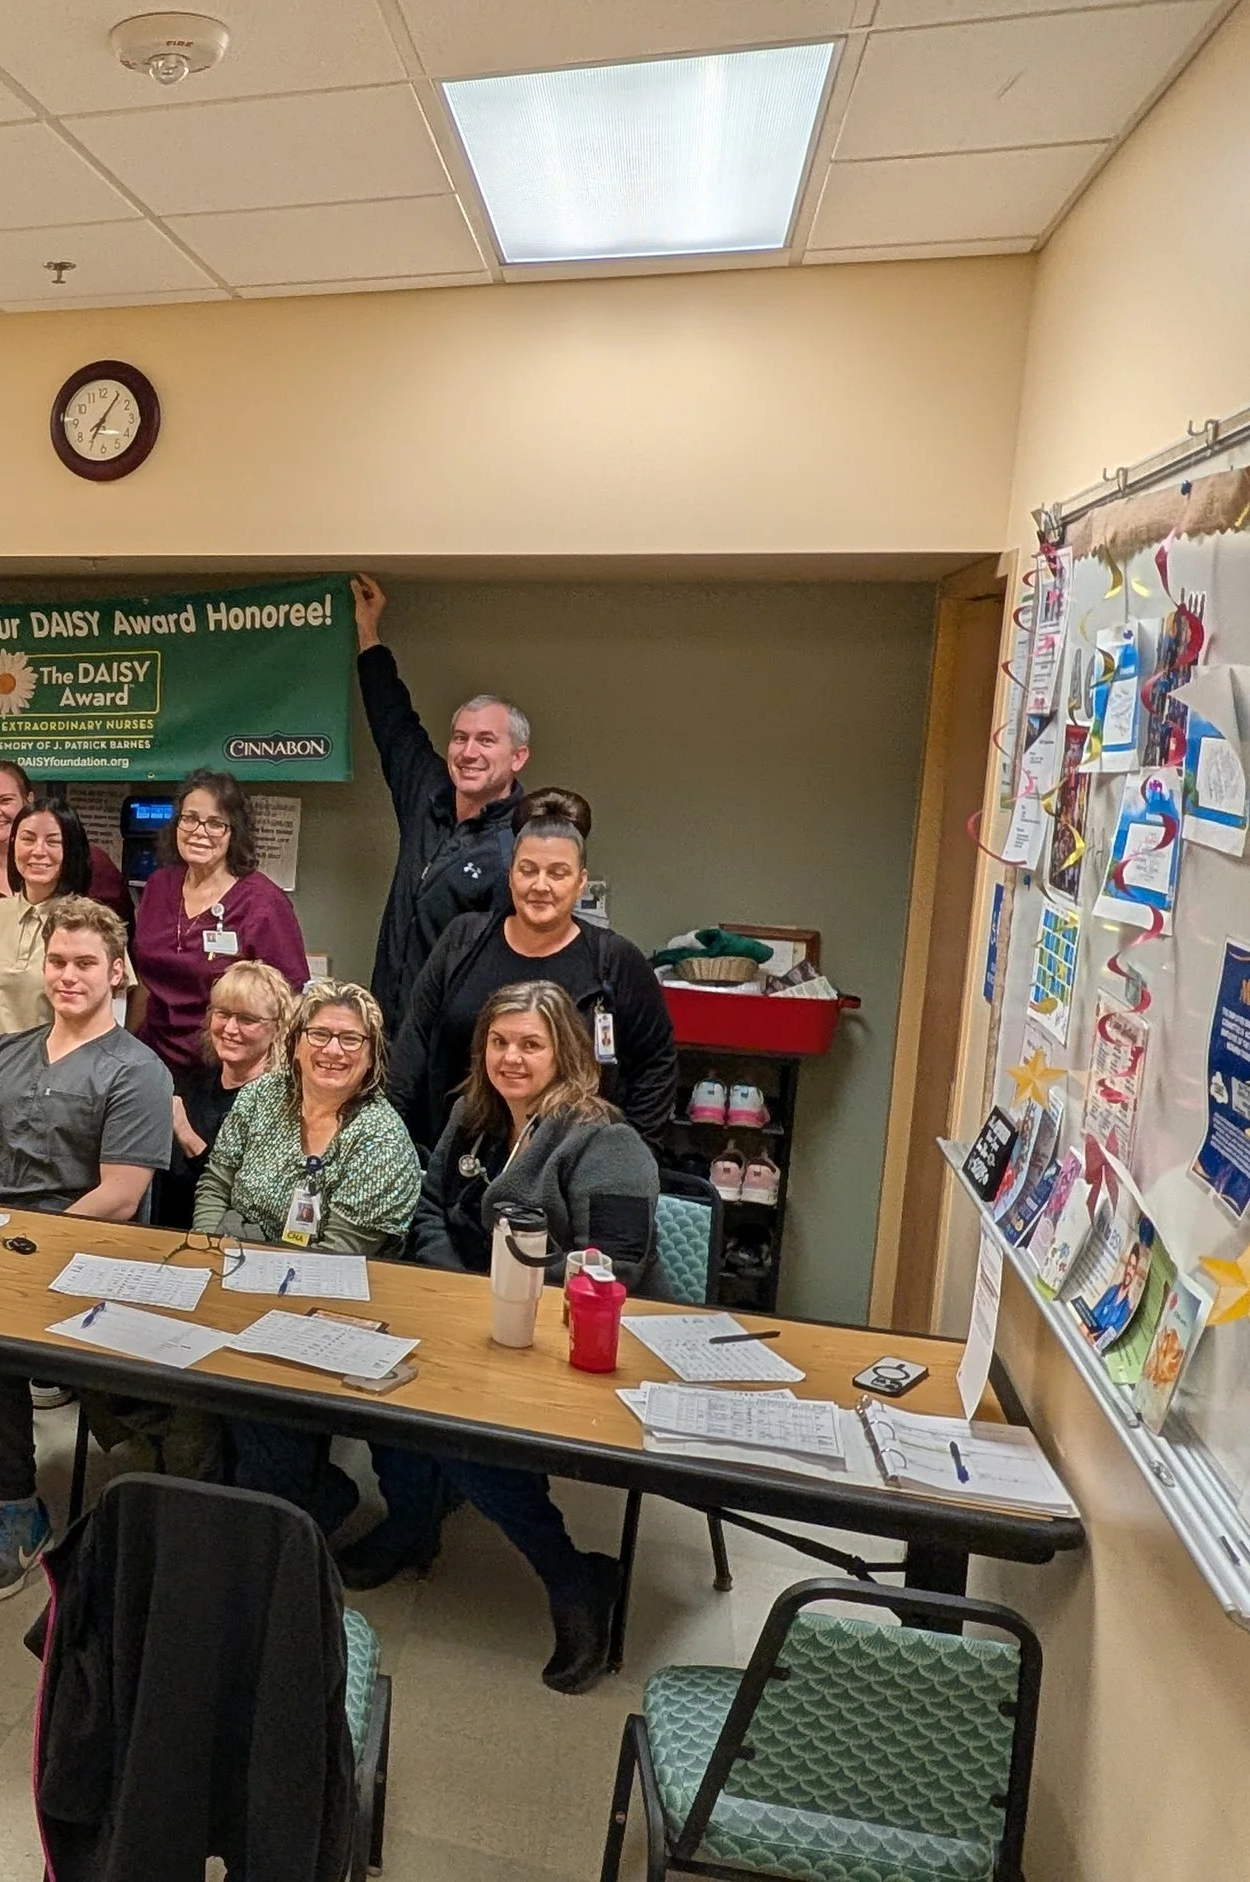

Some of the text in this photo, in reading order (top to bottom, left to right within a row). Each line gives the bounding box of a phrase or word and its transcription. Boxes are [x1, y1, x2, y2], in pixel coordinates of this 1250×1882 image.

[87, 392, 96, 404] 11
[98, 387, 108, 399] 12
[77, 403, 87, 415] 10
[124, 399, 130, 411] 2
[72, 418, 79, 429] 9
[128, 412, 135, 424] 3
[77, 432, 84, 443] 8
[123, 428, 130, 438] 4
[89, 440, 95, 451] 7
[100, 444, 107, 454] 6
[114, 438, 121, 449] 5
[30, 610, 100, 639] DAISY
[113, 604, 196, 636] Award
[206, 593, 332, 631] Honoree!
[39, 660, 151, 685] The DAISY
[1, 720, 102, 731] EXTRAORDINARY
[106, 719, 154, 730] NURSES
[36, 741, 51, 750] OF
[53, 741, 62, 750] J.
[64, 740, 107, 749] PATRICK
[110, 740, 151, 749] BARNES
[229, 739, 327, 757] CINNABON
[286, 1232, 304, 1242] CNA
